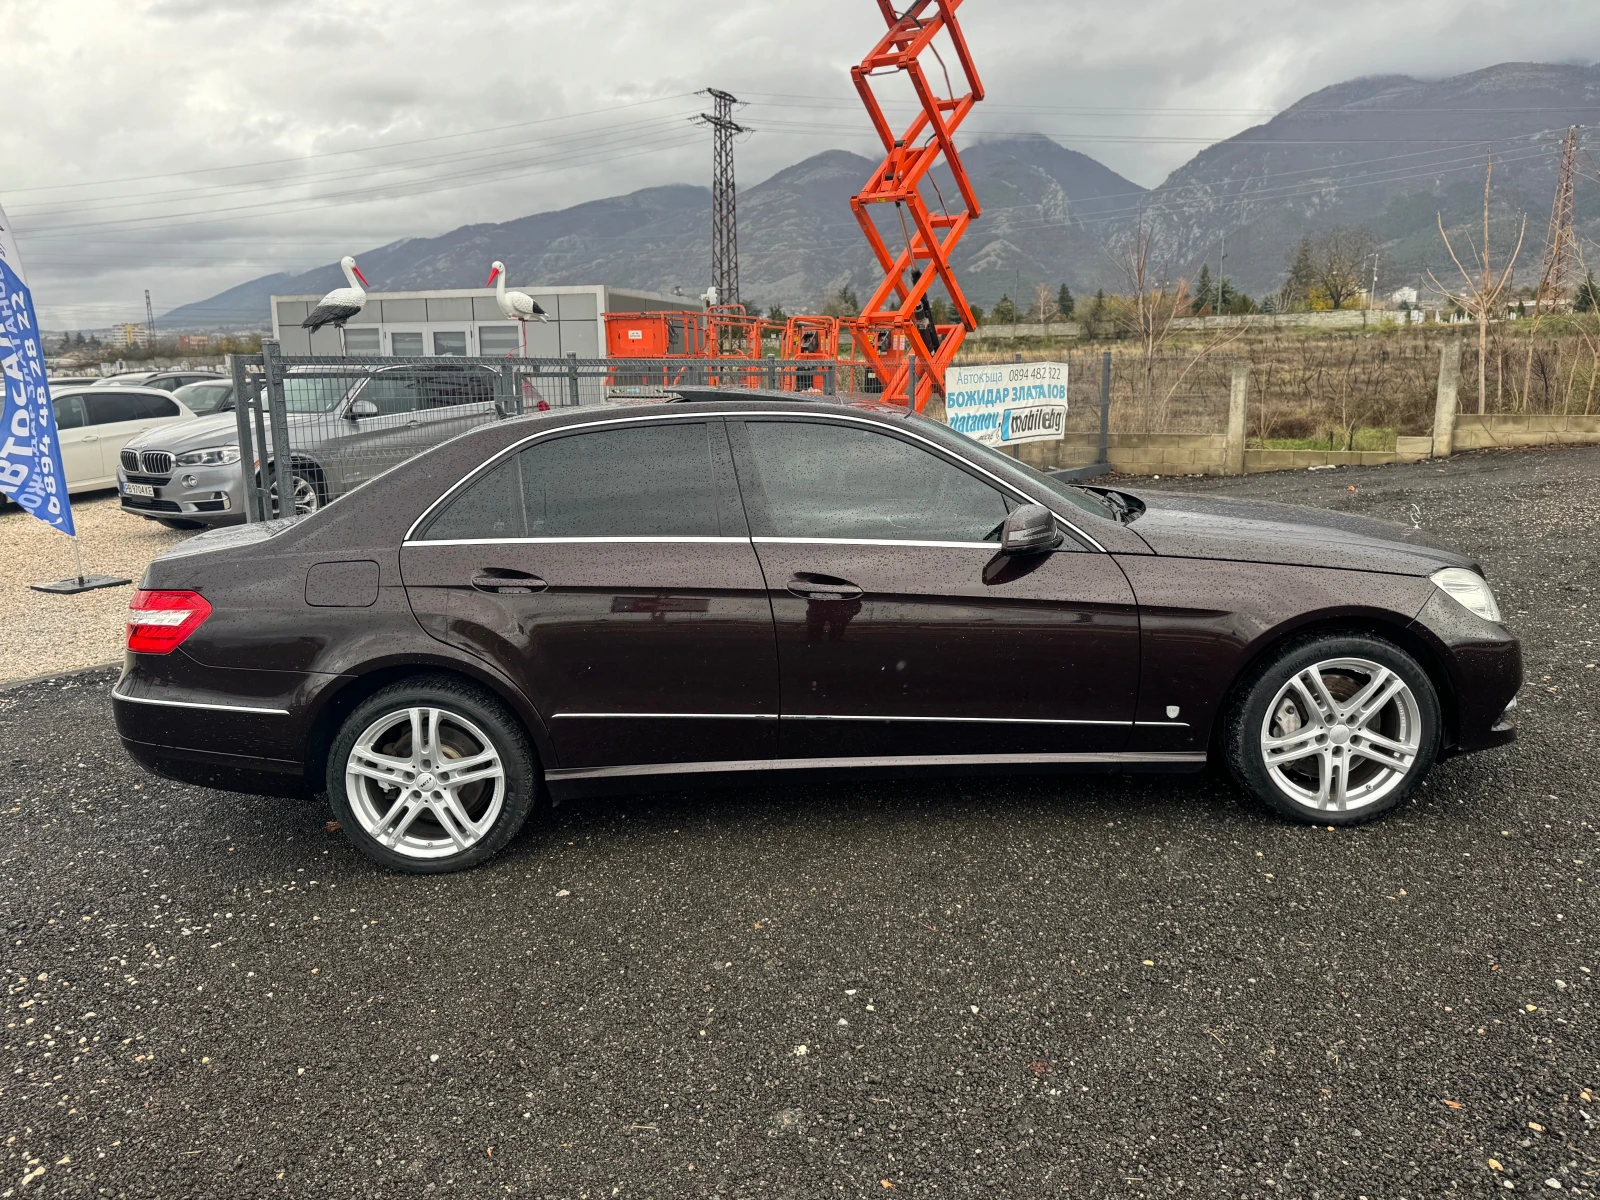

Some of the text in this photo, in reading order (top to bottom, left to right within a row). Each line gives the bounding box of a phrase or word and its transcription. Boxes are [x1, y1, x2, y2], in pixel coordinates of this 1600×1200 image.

[11, 290, 31, 330] 22
[24, 338, 42, 378] 28
[956, 372, 1003, 385] Автокъща
[1008, 368, 1029, 382] 0894
[1030, 367, 1046, 380] 482
[36, 386, 49, 427] 48
[947, 387, 1009, 408] БОЖИДАР
